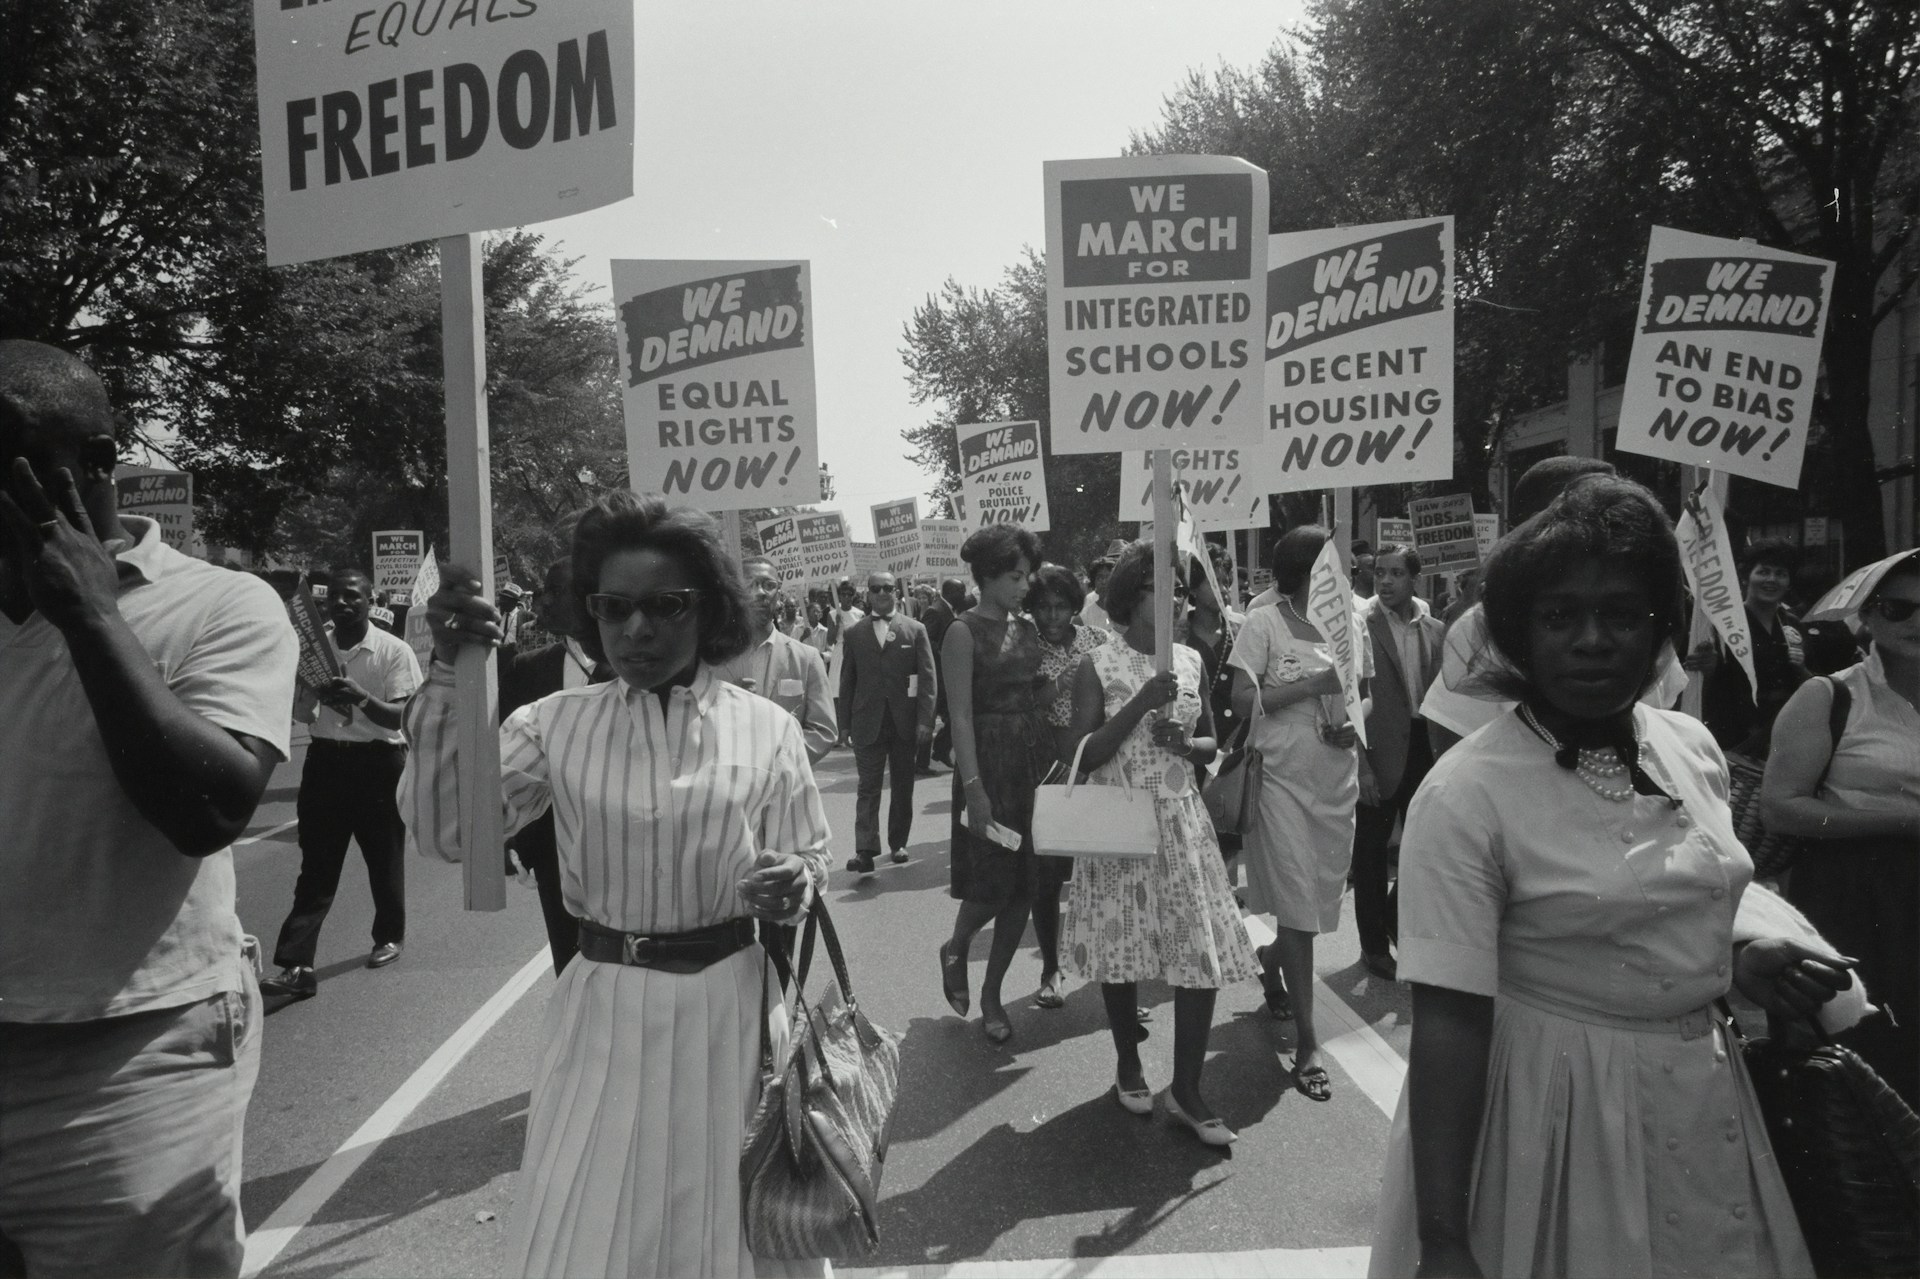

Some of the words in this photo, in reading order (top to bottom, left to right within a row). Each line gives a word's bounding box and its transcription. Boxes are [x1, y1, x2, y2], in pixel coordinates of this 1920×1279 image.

[287, 29, 616, 191] FREEDOM
[1129, 184, 1186, 213] WE
[1077, 216, 1237, 257] MARCH
[1128, 260, 1190, 278] FOR
[1313, 242, 1382, 294] WE
[1706, 261, 1773, 291] WE
[682, 278, 745, 322] WE
[1064, 292, 1250, 330] INTEGRATED
[1266, 265, 1438, 349] DEMAND
[1655, 293, 1815, 326] DEMAND
[639, 305, 797, 372] DEMAND
[1066, 339, 1249, 376] SCHOOLS
[1284, 346, 1428, 387] DECENT
[1655, 340, 1712, 372] AN
[1724, 351, 1802, 390] END
[658, 379, 788, 410] EQUAL
[1079, 378, 1242, 433] NOW!
[1656, 372, 1702, 403] TO
[1713, 383, 1795, 424] BIAS
[1269, 388, 1441, 430] HOUSING
[658, 415, 795, 448] RIGHTS
[986, 428, 1013, 449] WE
[1649, 407, 1791, 462] NOW!
[968, 439, 1035, 472] DEMAND
[1281, 417, 1433, 473] NOW!
[662, 446, 801, 495] NOW!
[1143, 450, 1239, 470] RGHTS
[140, 476, 166, 490] WE
[975, 473, 998, 484] AN
[1002, 471, 1032, 482] END
[122, 487, 187, 506] DEMAND
[979, 496, 1032, 508] BRUTALITY
[989, 486, 1024, 497] POLICE
[889, 506, 901, 516] WE
[980, 502, 1041, 526] NOW!
[1415, 503, 1439, 513] UAW
[1441, 498, 1465, 509] SAYS
[774, 520, 792, 535] WE
[802, 523, 840, 537] MARCH
[812, 517, 826, 526] WE
[880, 512, 913, 530] MARCH
[891, 525, 905, 534] FOR
[921, 524, 936, 533] CIVIL
[939, 525, 960, 533] RIGHTS
[1415, 511, 1454, 529] JOBS
[879, 538, 899, 550] FIRST
[900, 532, 919, 545] CLASS
[1383, 529, 1412, 537] MARCH
[1416, 525, 1474, 547] FREEDOM
[771, 548, 784, 557] AN
[787, 546, 800, 554] EN
[802, 540, 847, 554] INTEGRATED
[804, 550, 849, 565] SCHOOLS
[880, 542, 921, 560] CITIZENSHIP
[924, 543, 960, 551] MPLOYMENT
[811, 559, 848, 577] NOW!
[888, 553, 920, 573] NOW!
[1682, 505, 1733, 615] FREEDOM
[291, 594, 315, 635] MARCH
[1305, 562, 1352, 668] FREEDOM
[1722, 615, 1735, 630] IN
[1725, 628, 1749, 658] '63
